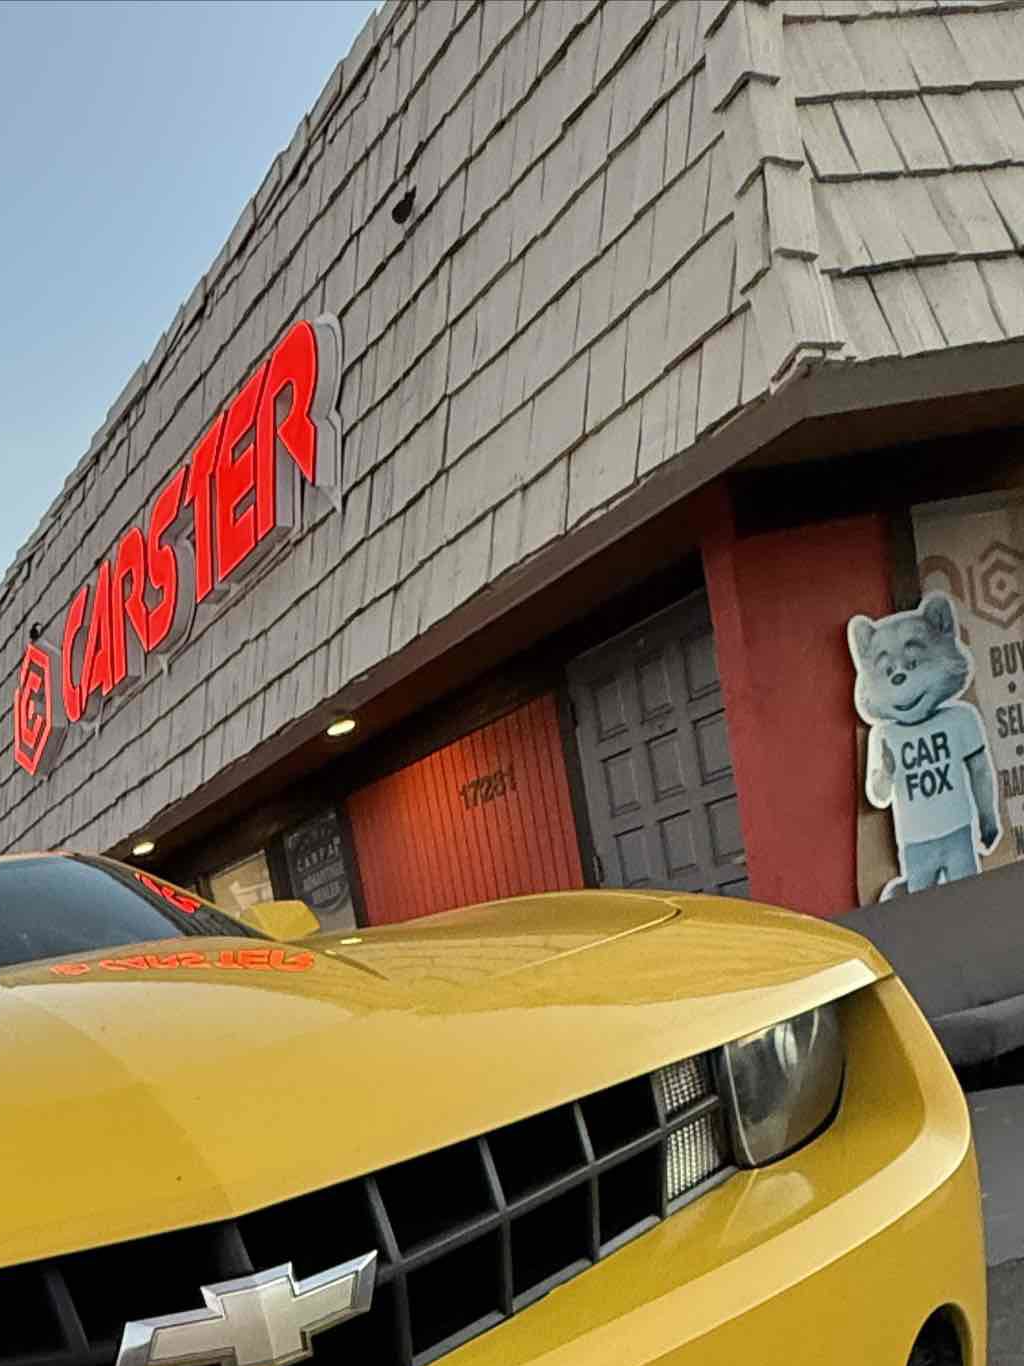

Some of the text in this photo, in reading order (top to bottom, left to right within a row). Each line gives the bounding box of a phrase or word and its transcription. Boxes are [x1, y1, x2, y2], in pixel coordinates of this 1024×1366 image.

[62, 319, 317, 722] CARSTER
[902, 731, 951, 771] CAR
[905, 763, 954, 801] FOX
